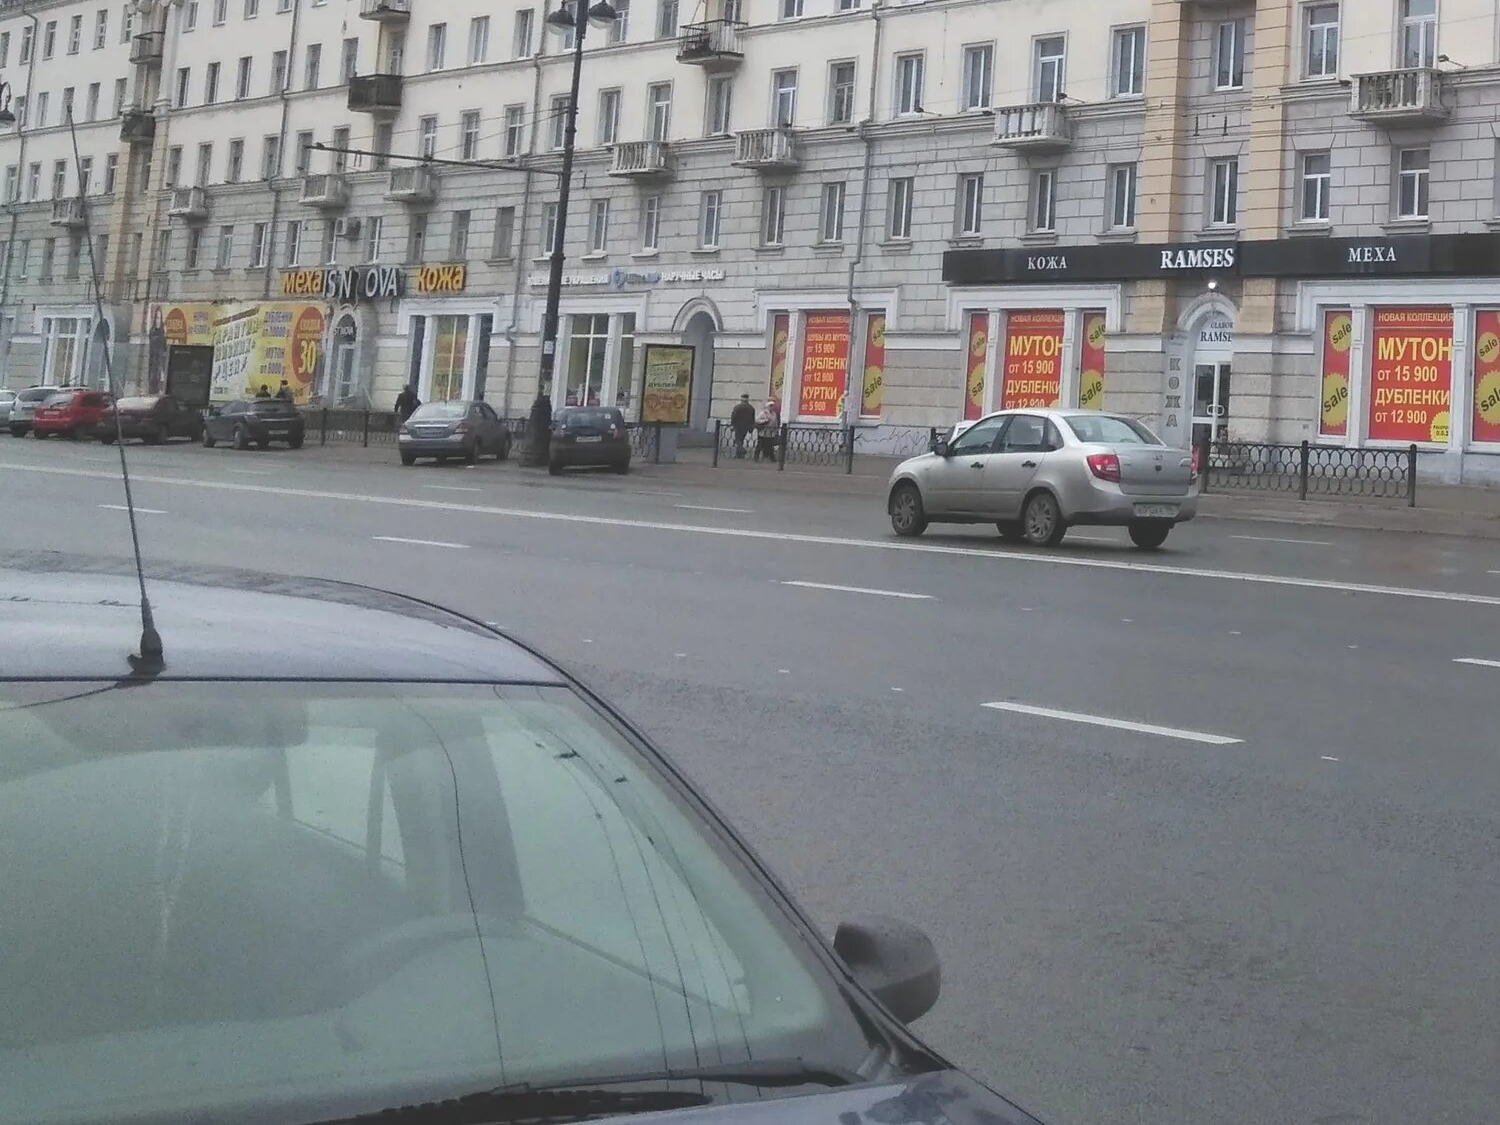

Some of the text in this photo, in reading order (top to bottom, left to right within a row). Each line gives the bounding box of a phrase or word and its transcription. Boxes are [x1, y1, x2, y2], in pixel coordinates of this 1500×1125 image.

[1028, 256, 1068, 270] КОЖА
[1160, 248, 1235, 270] RAMSES
[1347, 247, 1397, 263] МЕХА
[284, 270, 322, 294] меха
[417, 264, 465, 292] кожа
[1011, 314, 1065, 323] НОВАЯ КОЛЛЕКЦИ
[1378, 312, 1406, 322] НОВАЯ
[833, 333, 848, 342] МУТО
[1200, 331, 1232, 342] RAMSE
[1331, 322, 1352, 345] sale
[815, 343, 823, 353] 15
[823, 343, 835, 354] 900
[1377, 337, 1453, 361] МУТОН
[1479, 337, 1498, 357] sale
[298, 340, 317, 374] 30
[804, 356, 847, 371] ДУБЛЕНК
[1009, 360, 1054, 374] от 15 900
[1377, 366, 1437, 382] от 15 900
[814, 373, 821, 383] 12
[821, 373, 834, 383] 900
[864, 375, 883, 398] sale
[971, 377, 985, 396] sal
[802, 386, 837, 399] КУРТКИ
[1080, 380, 1103, 405] sale
[1165, 357, 1182, 428] КОЖА
[1323, 385, 1349, 413] sale
[1375, 388, 1450, 406] ДУБЛЕНКИ
[1375, 410, 1427, 424] от 12 900
